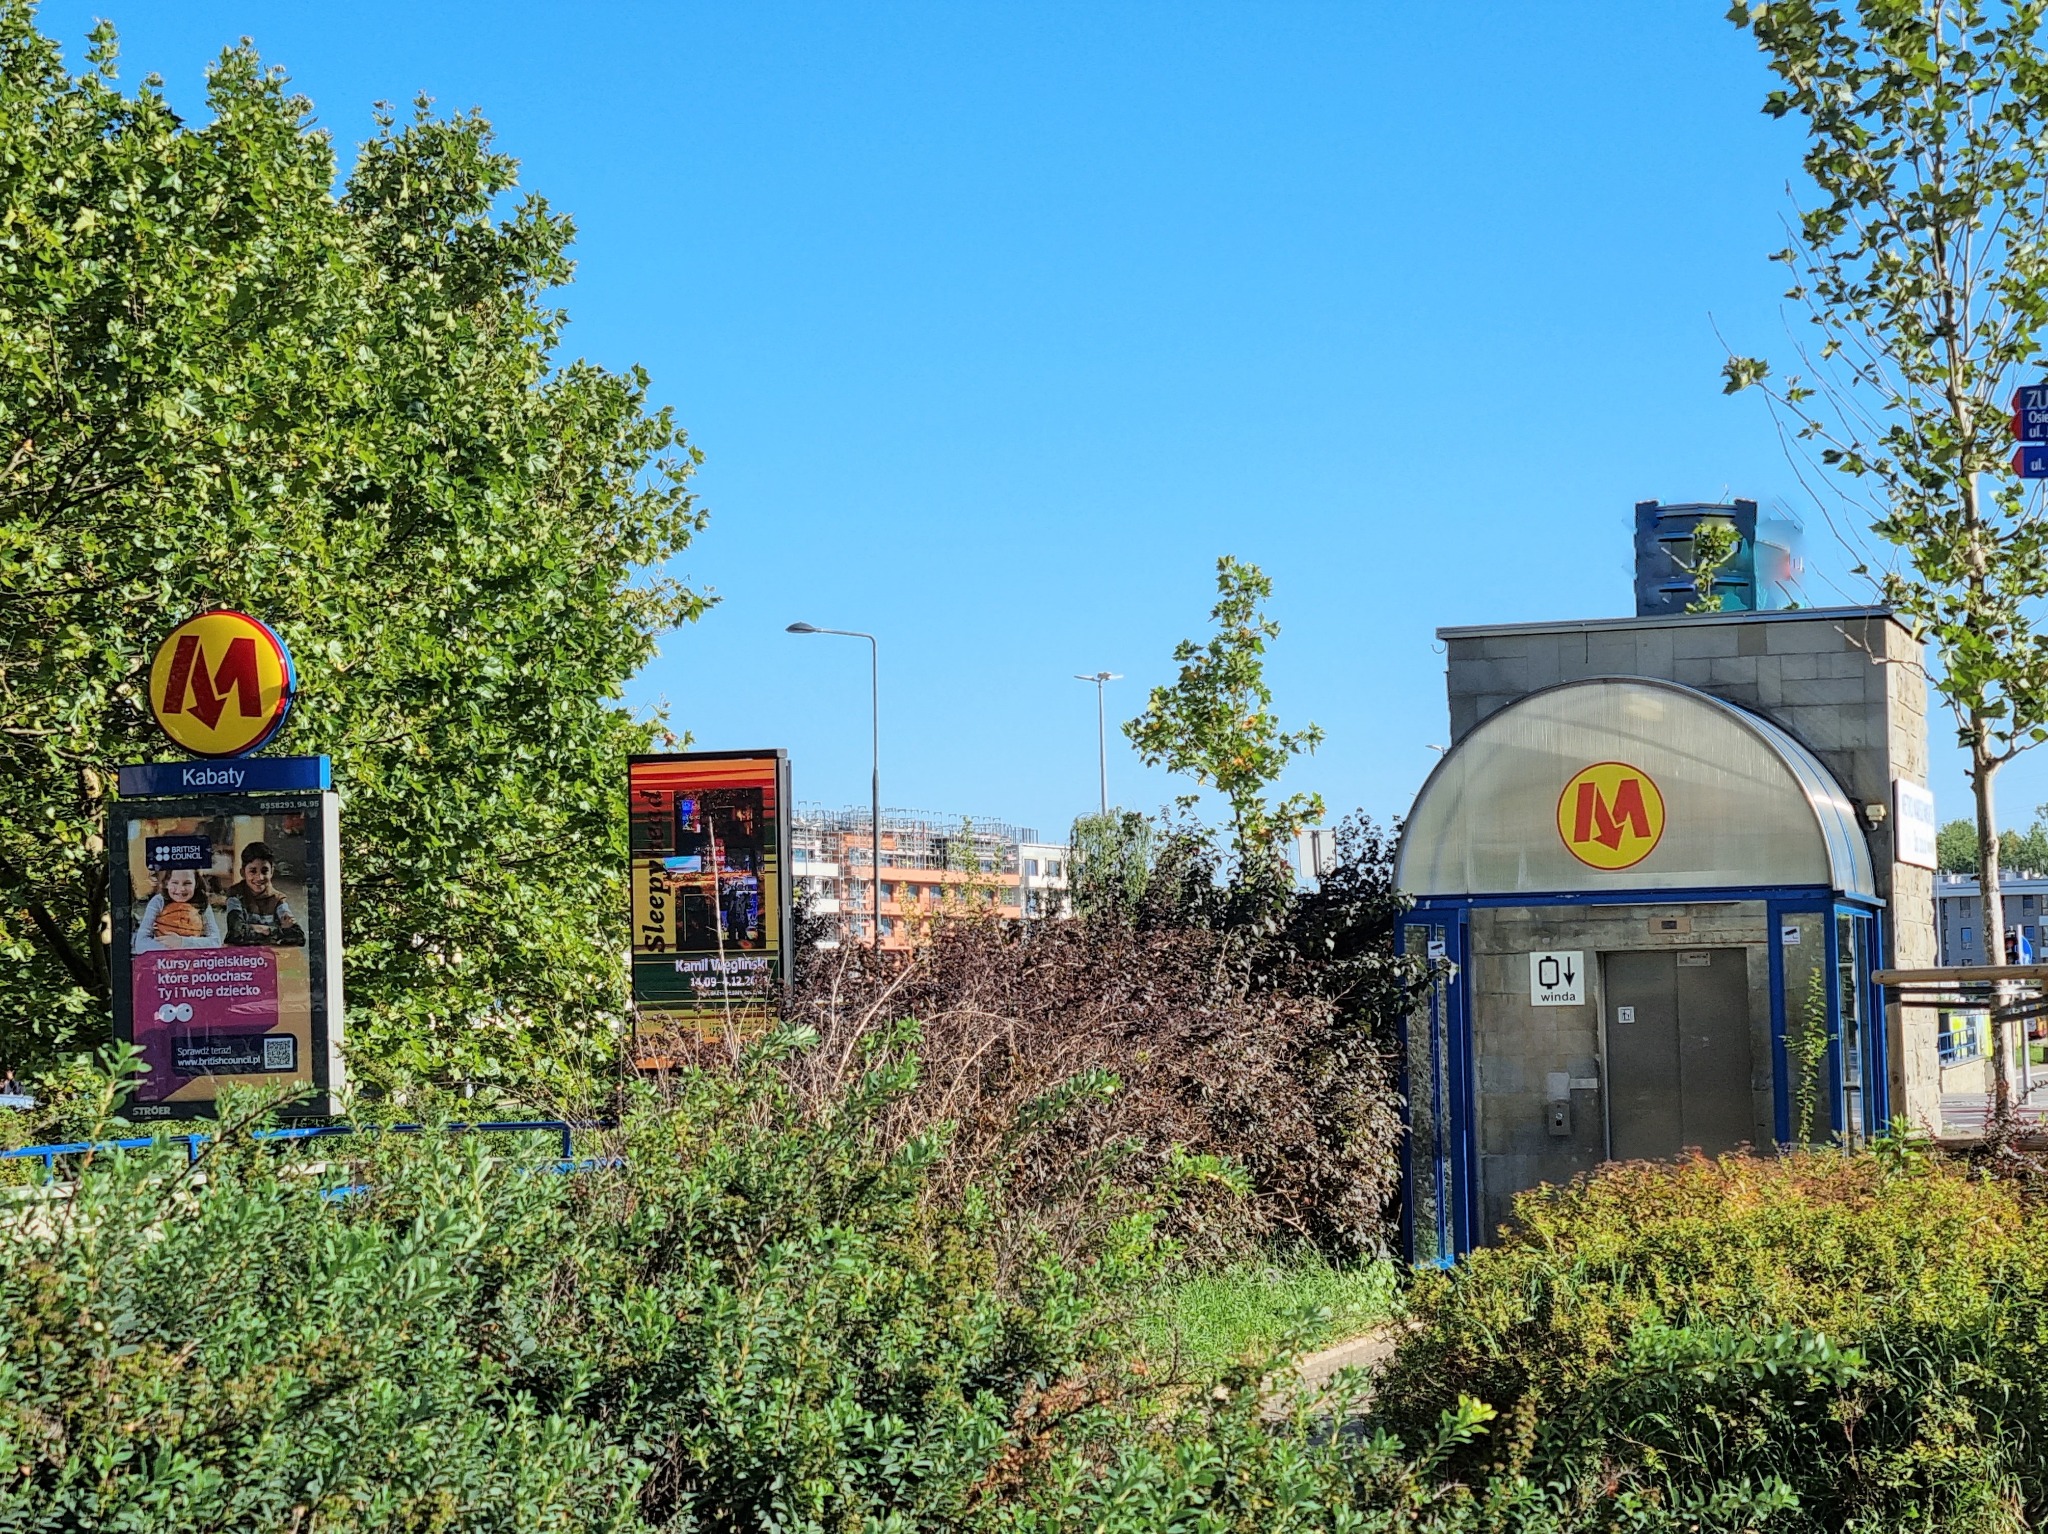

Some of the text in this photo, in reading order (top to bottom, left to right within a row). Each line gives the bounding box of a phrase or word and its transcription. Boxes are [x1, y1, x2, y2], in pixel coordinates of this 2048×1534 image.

[2026, 390, 2048, 410] ZU
[2029, 425, 2043, 438] ul.
[2030, 457, 2046, 472] ul.
[162, 635, 263, 731] M
[182, 767, 245, 788] Kabaty
[1573, 778, 1652, 851] M
[171, 845, 200, 854] BRITISH
[171, 852, 203, 861] COUNCIL
[157, 955, 268, 971] Kursy angielskiego,
[675, 957, 708, 973] Kamil
[158, 971, 253, 985] które pokochasz
[158, 984, 261, 1000] Ty i Twoje dziecko
[1540, 991, 1576, 1002] winda
[177, 1055, 261, 1066] www.britishcouncil.pl
